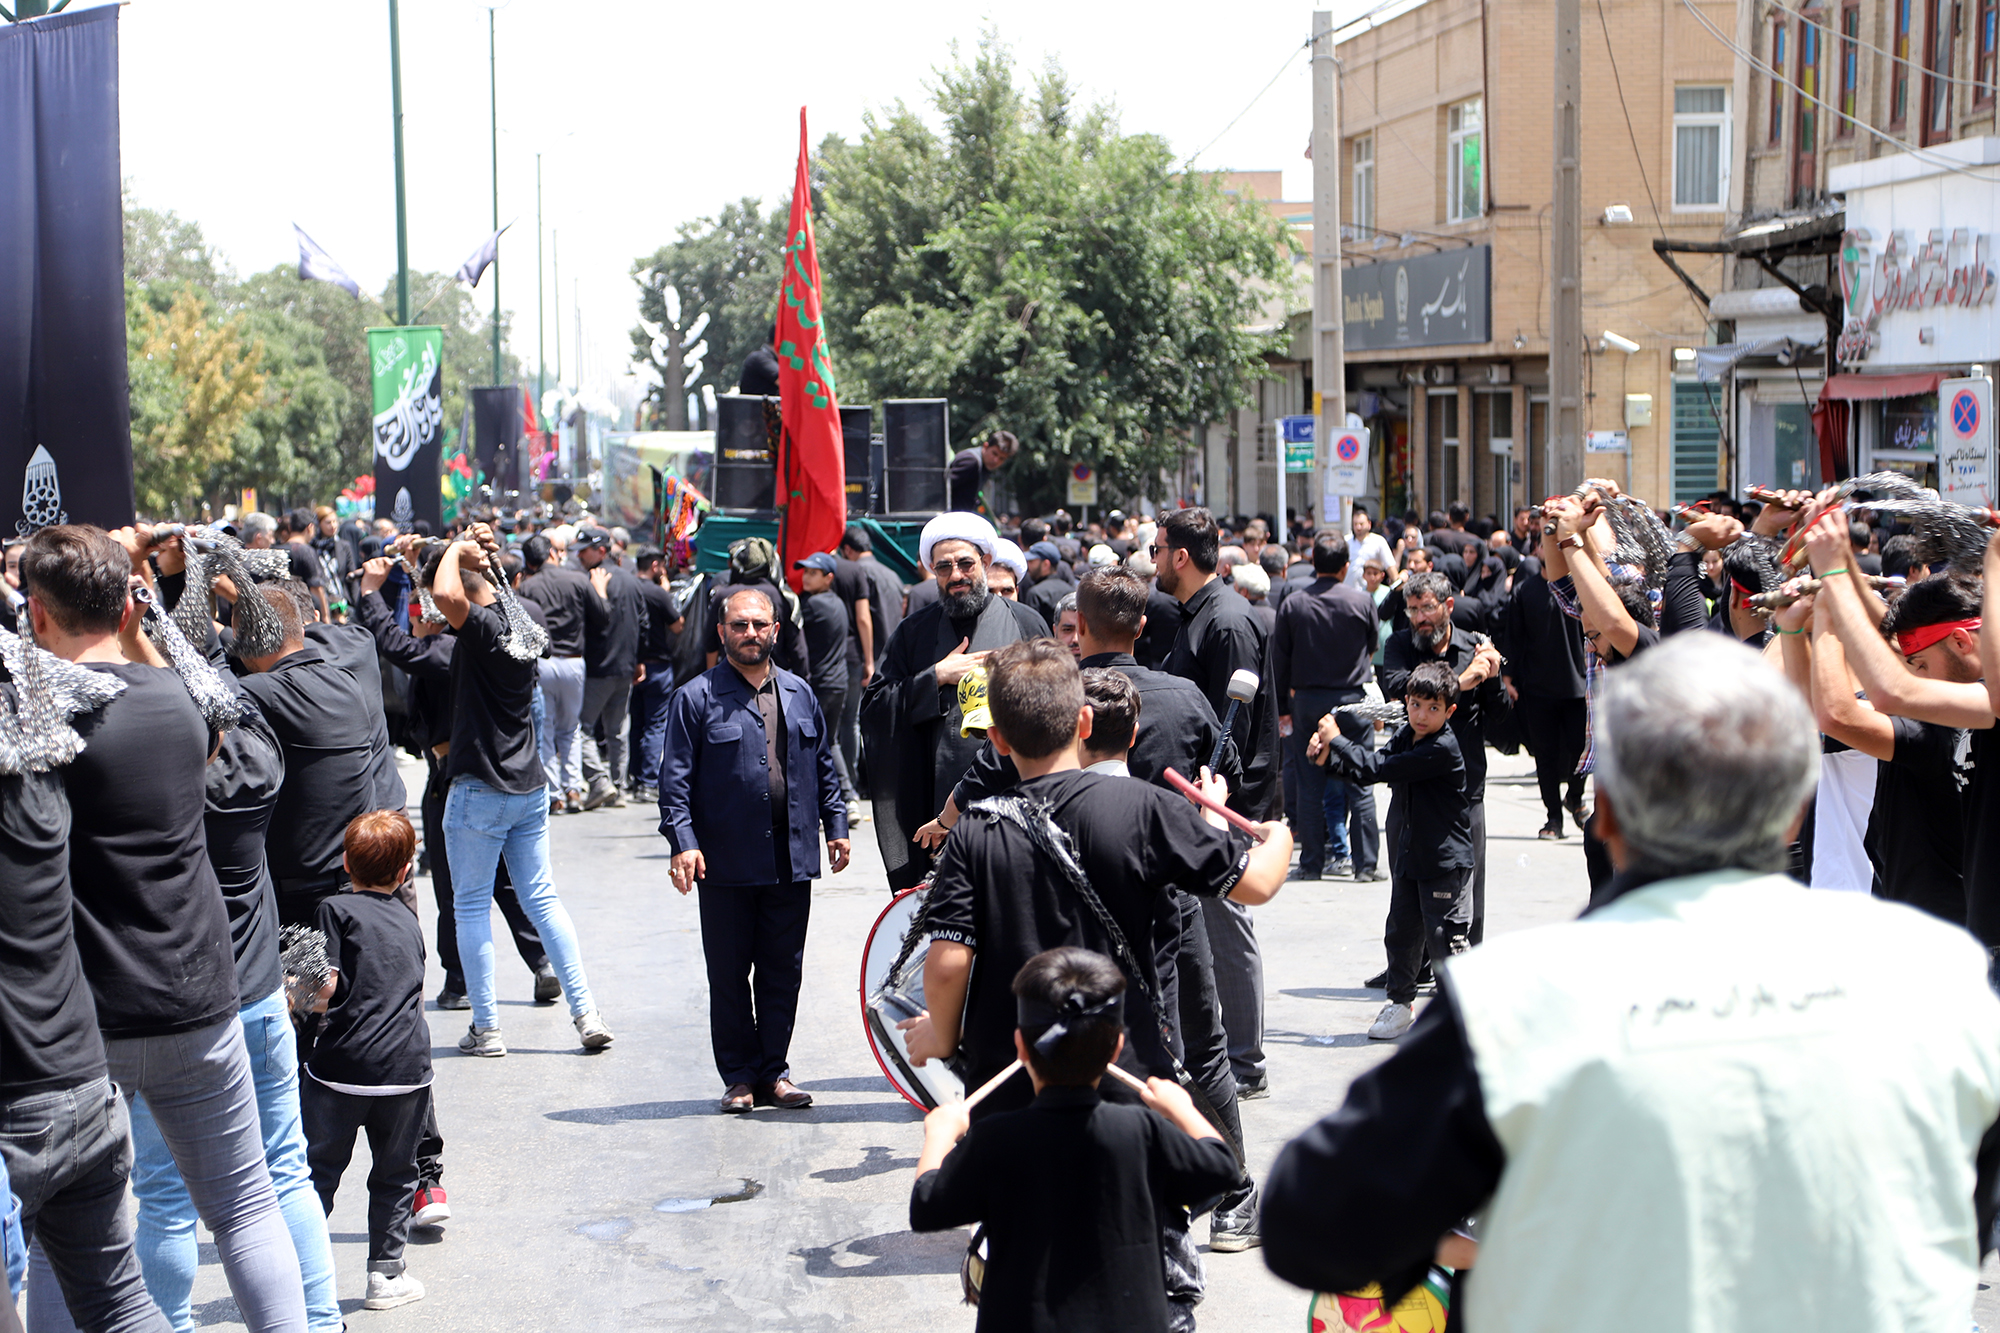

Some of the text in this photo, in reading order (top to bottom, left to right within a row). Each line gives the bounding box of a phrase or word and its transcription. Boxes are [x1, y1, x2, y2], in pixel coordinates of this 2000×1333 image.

[1344, 290, 1385, 330] Bank Sepah
[1420, 256, 1470, 336] بانک سپه
[1945, 447, 1988, 466] ایستگاه تاکسی
